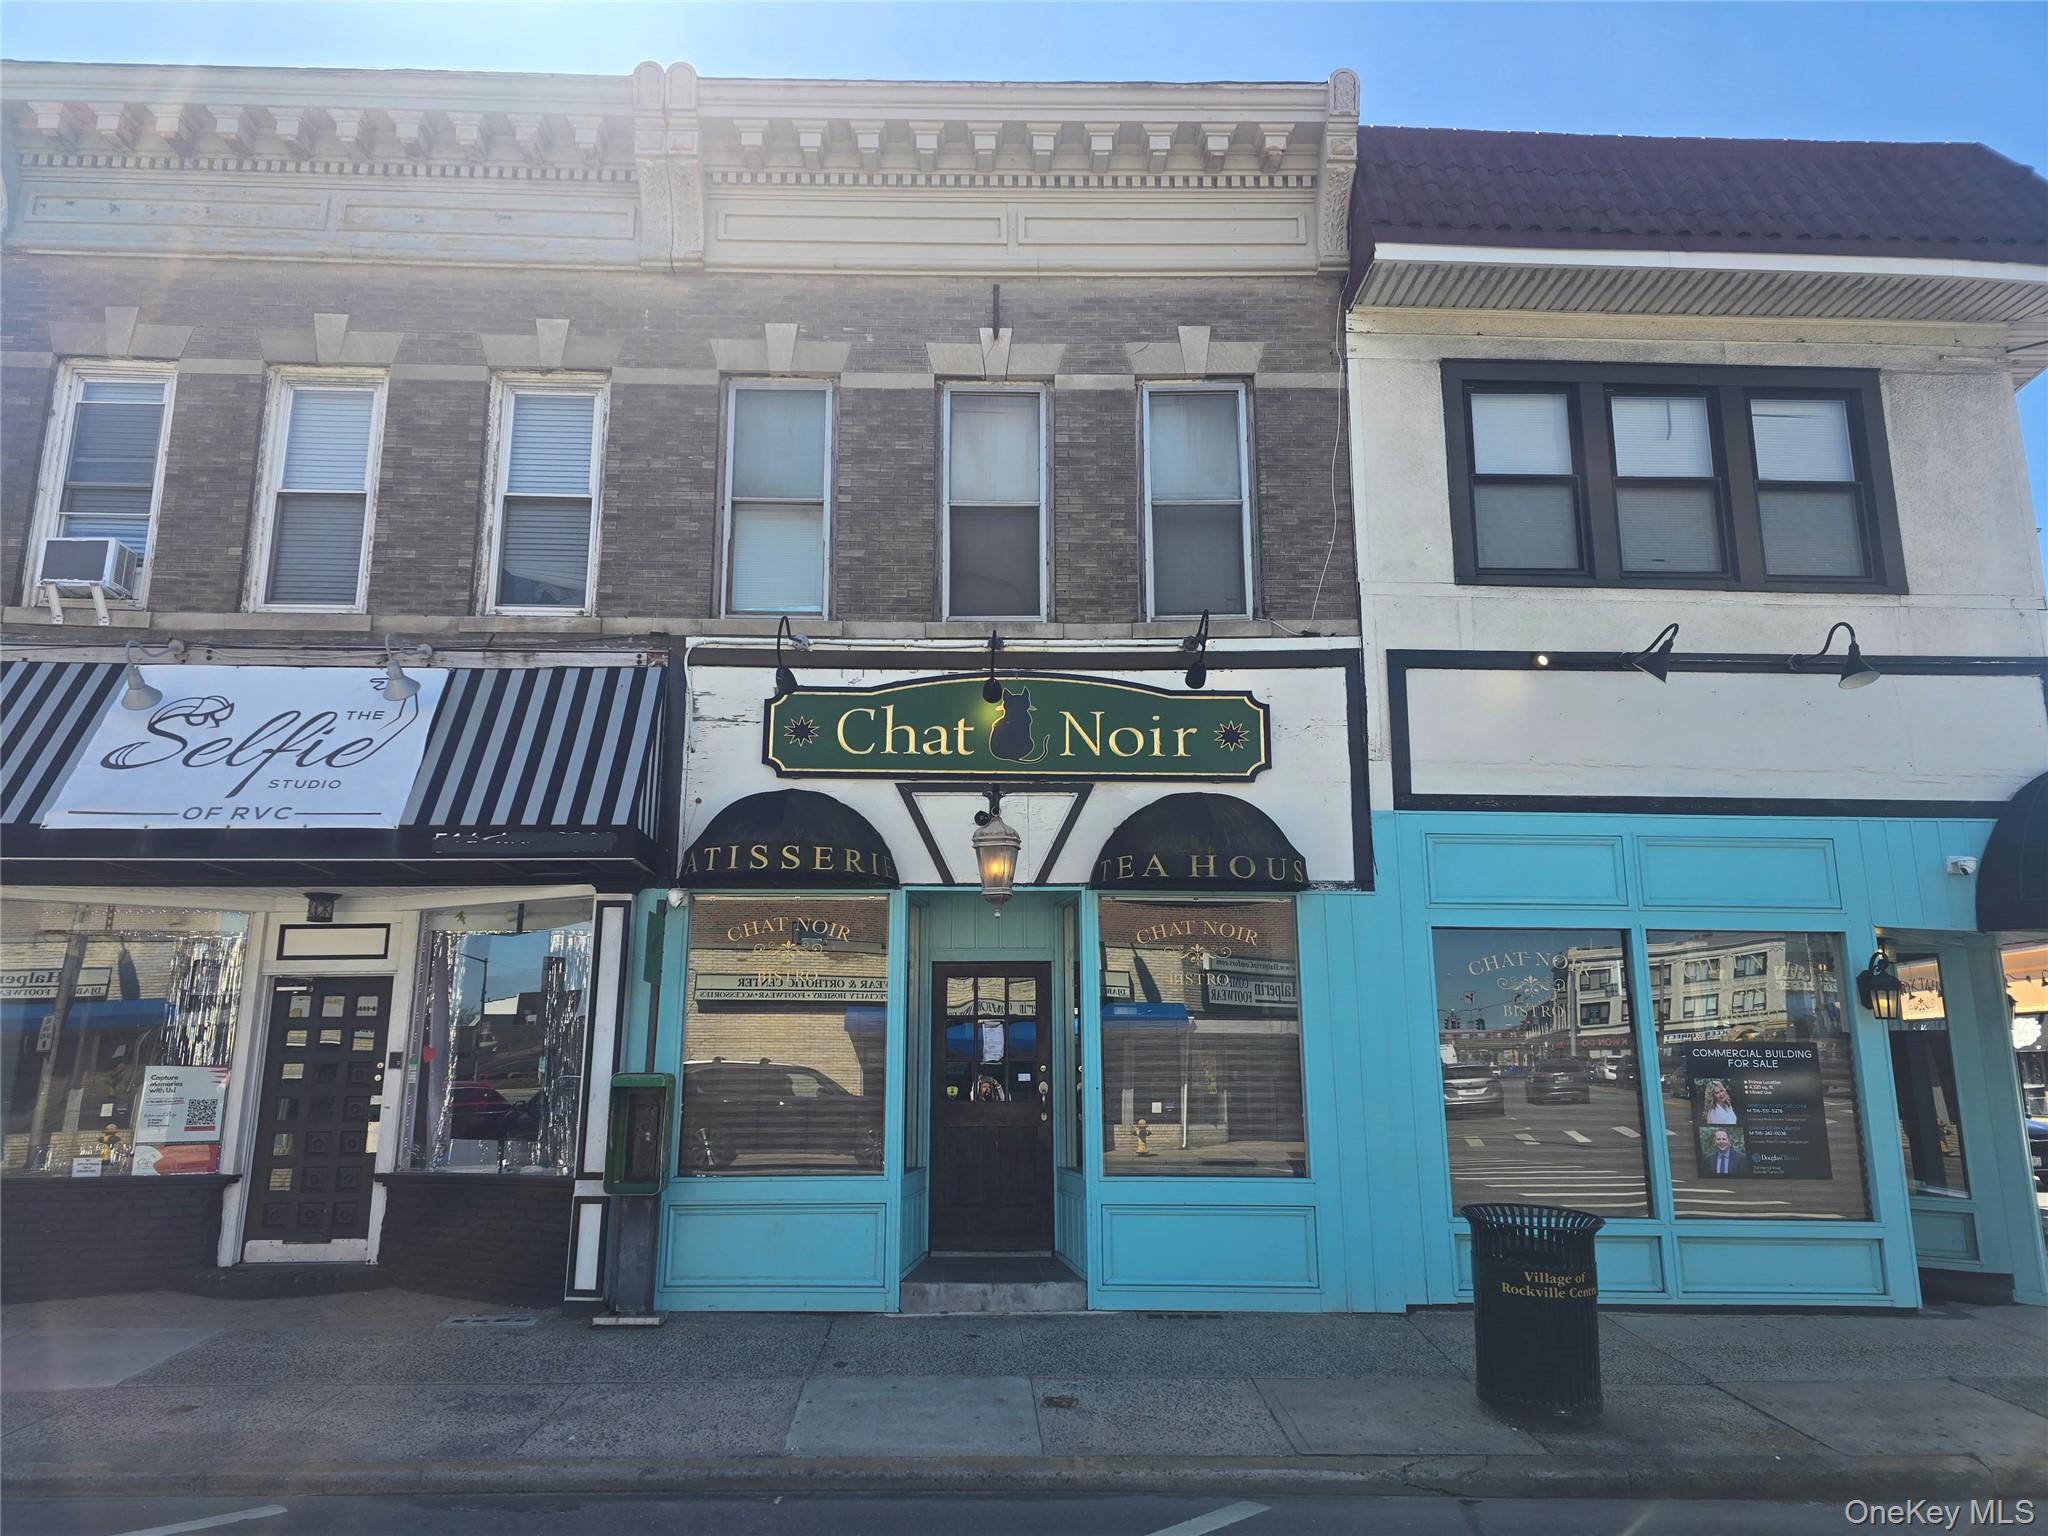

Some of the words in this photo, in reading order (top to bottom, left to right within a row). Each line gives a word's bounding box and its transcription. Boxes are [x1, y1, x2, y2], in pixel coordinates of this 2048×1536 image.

[346, 710, 385, 721] THE
[836, 704, 975, 756] Chat
[1059, 710, 1199, 758] Noir
[100, 696, 388, 798] Selfie
[267, 779, 342, 790] STUDIO
[182, 807, 223, 821] OF
[230, 806, 293, 821] RVC
[684, 844, 895, 879] ATISSERIE
[1100, 854, 1170, 882] TEA
[1188, 854, 1305, 883] HOUS
[726, 916, 789, 942] CHAT
[796, 916, 851, 943] NOIR
[1135, 919, 1196, 945] CHAT
[1203, 920, 1259, 946] NOIR
[1467, 951, 1528, 977] CHAT
[756, 970, 820, 983] BISTRO
[1503, 1004, 1564, 1018] BISTRO
[1692, 1048, 1762, 1059] COMMERCIAL
[1765, 1049, 1813, 1059] BUILDING
[1728, 1059, 1749, 1068] FOR
[1753, 1059, 1779, 1069] SALE
[150, 1074, 179, 1082] Capture
[1523, 1271, 1572, 1287] Village
[1575, 1272, 1586, 1284] of
[1501, 1281, 1567, 1299] Rockville
[1569, 1287, 1597, 1298] Centr
